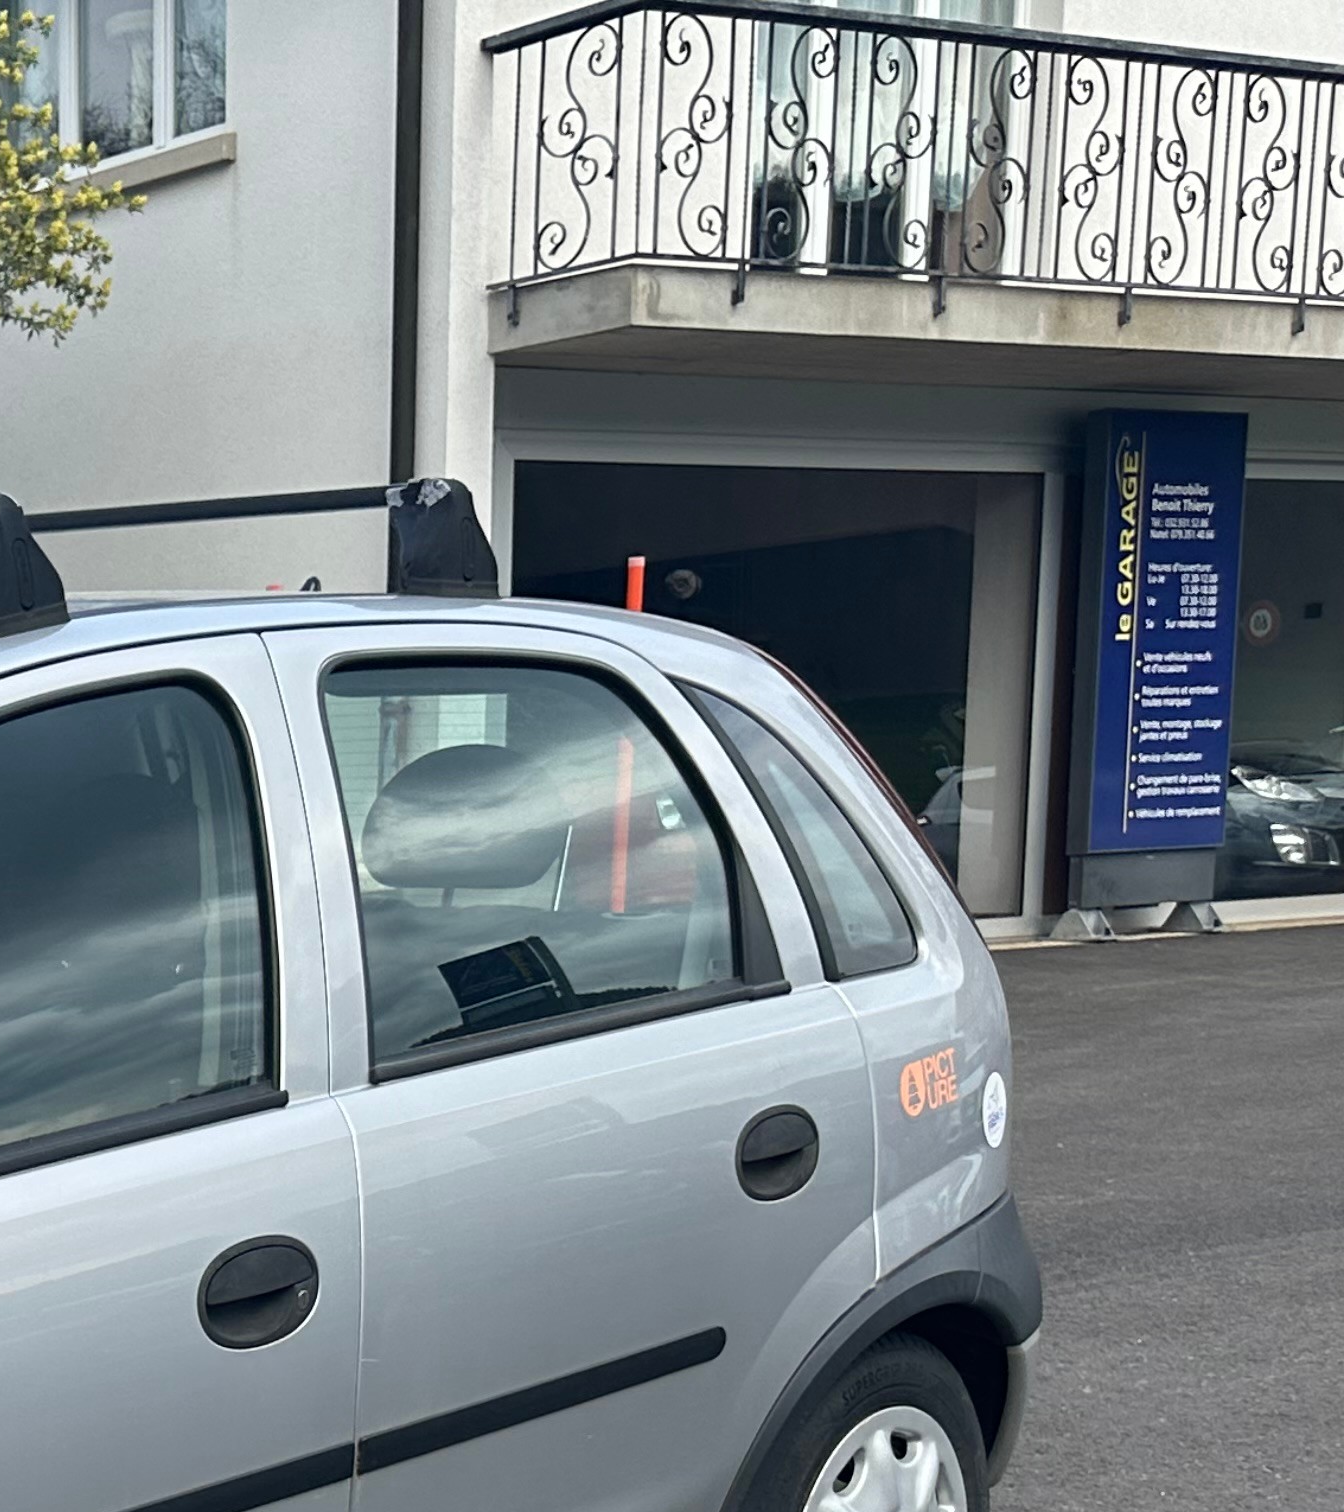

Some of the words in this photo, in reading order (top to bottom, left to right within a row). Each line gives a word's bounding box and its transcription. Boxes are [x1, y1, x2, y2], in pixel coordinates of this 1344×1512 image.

[1152, 483, 1210, 496] Automobiles
[1183, 498, 1215, 515] Thierry
[1116, 450, 1139, 607] GARAGE
[1115, 614, 1132, 641] le
